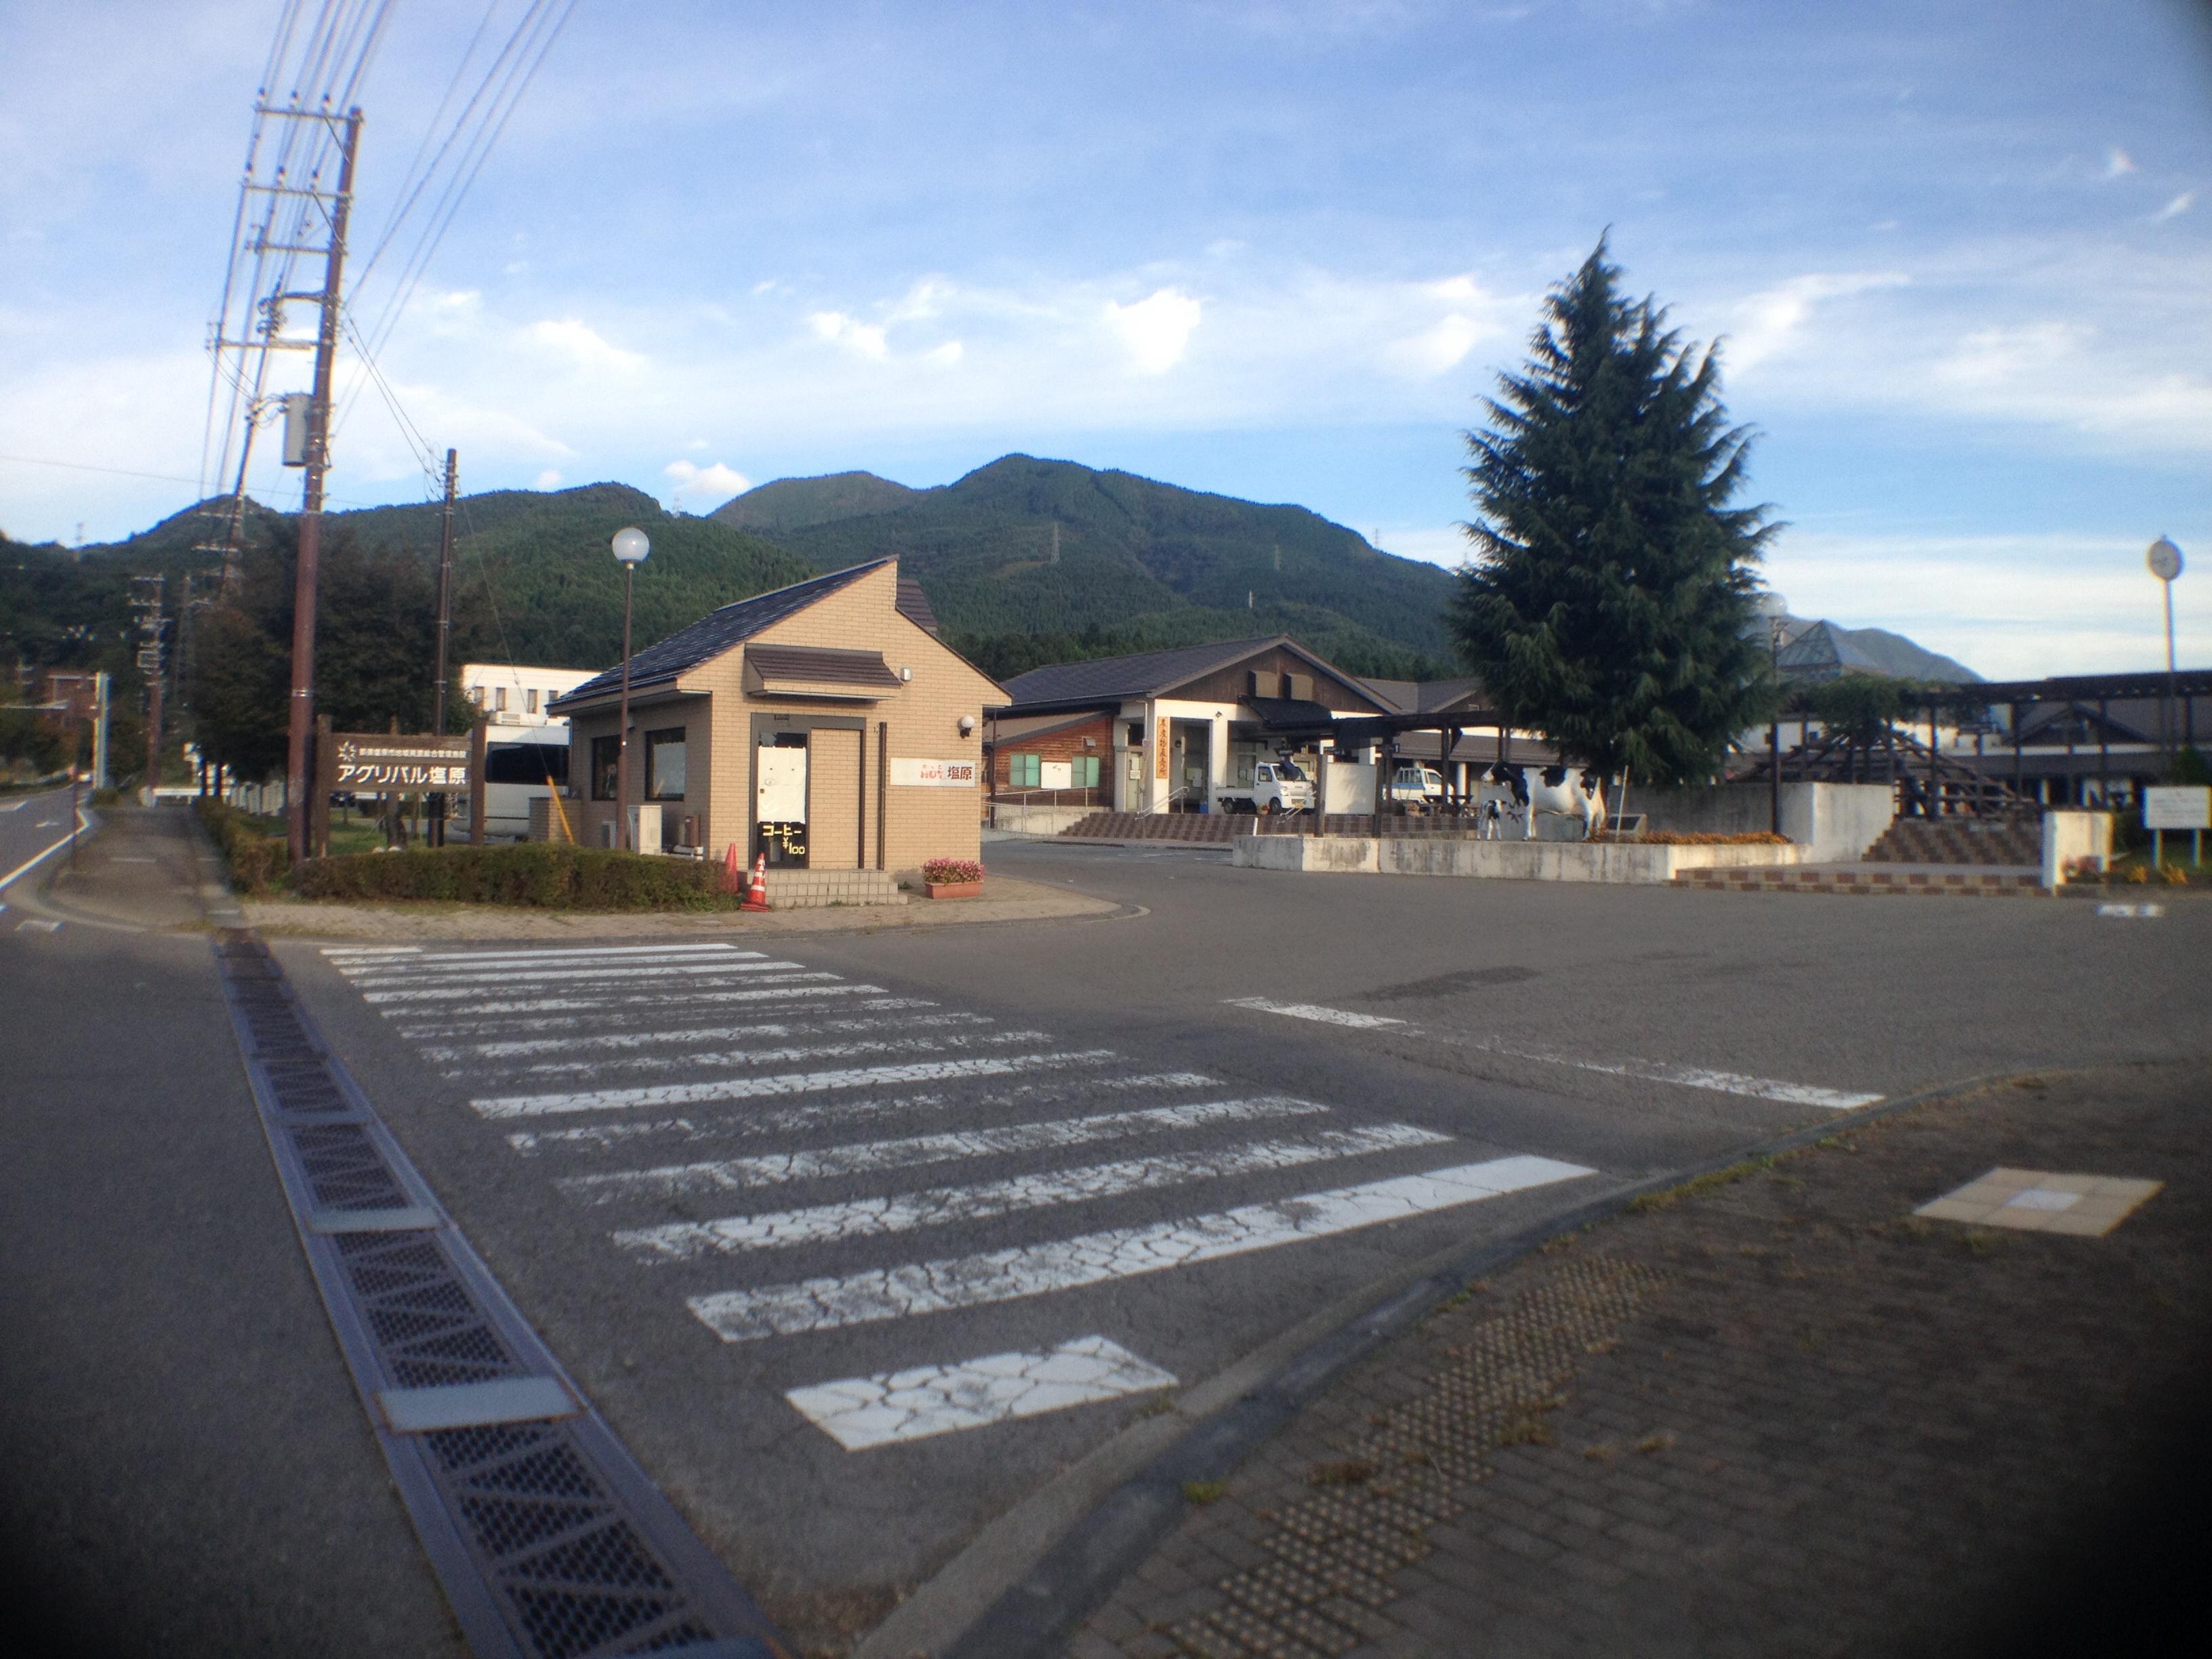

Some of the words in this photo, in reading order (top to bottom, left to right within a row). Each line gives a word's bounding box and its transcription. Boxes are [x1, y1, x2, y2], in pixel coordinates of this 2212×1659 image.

[337, 765, 466, 784] アグリパル塩原
[947, 766, 973, 780] 塩原
[762, 824, 802, 836] コーヒー
